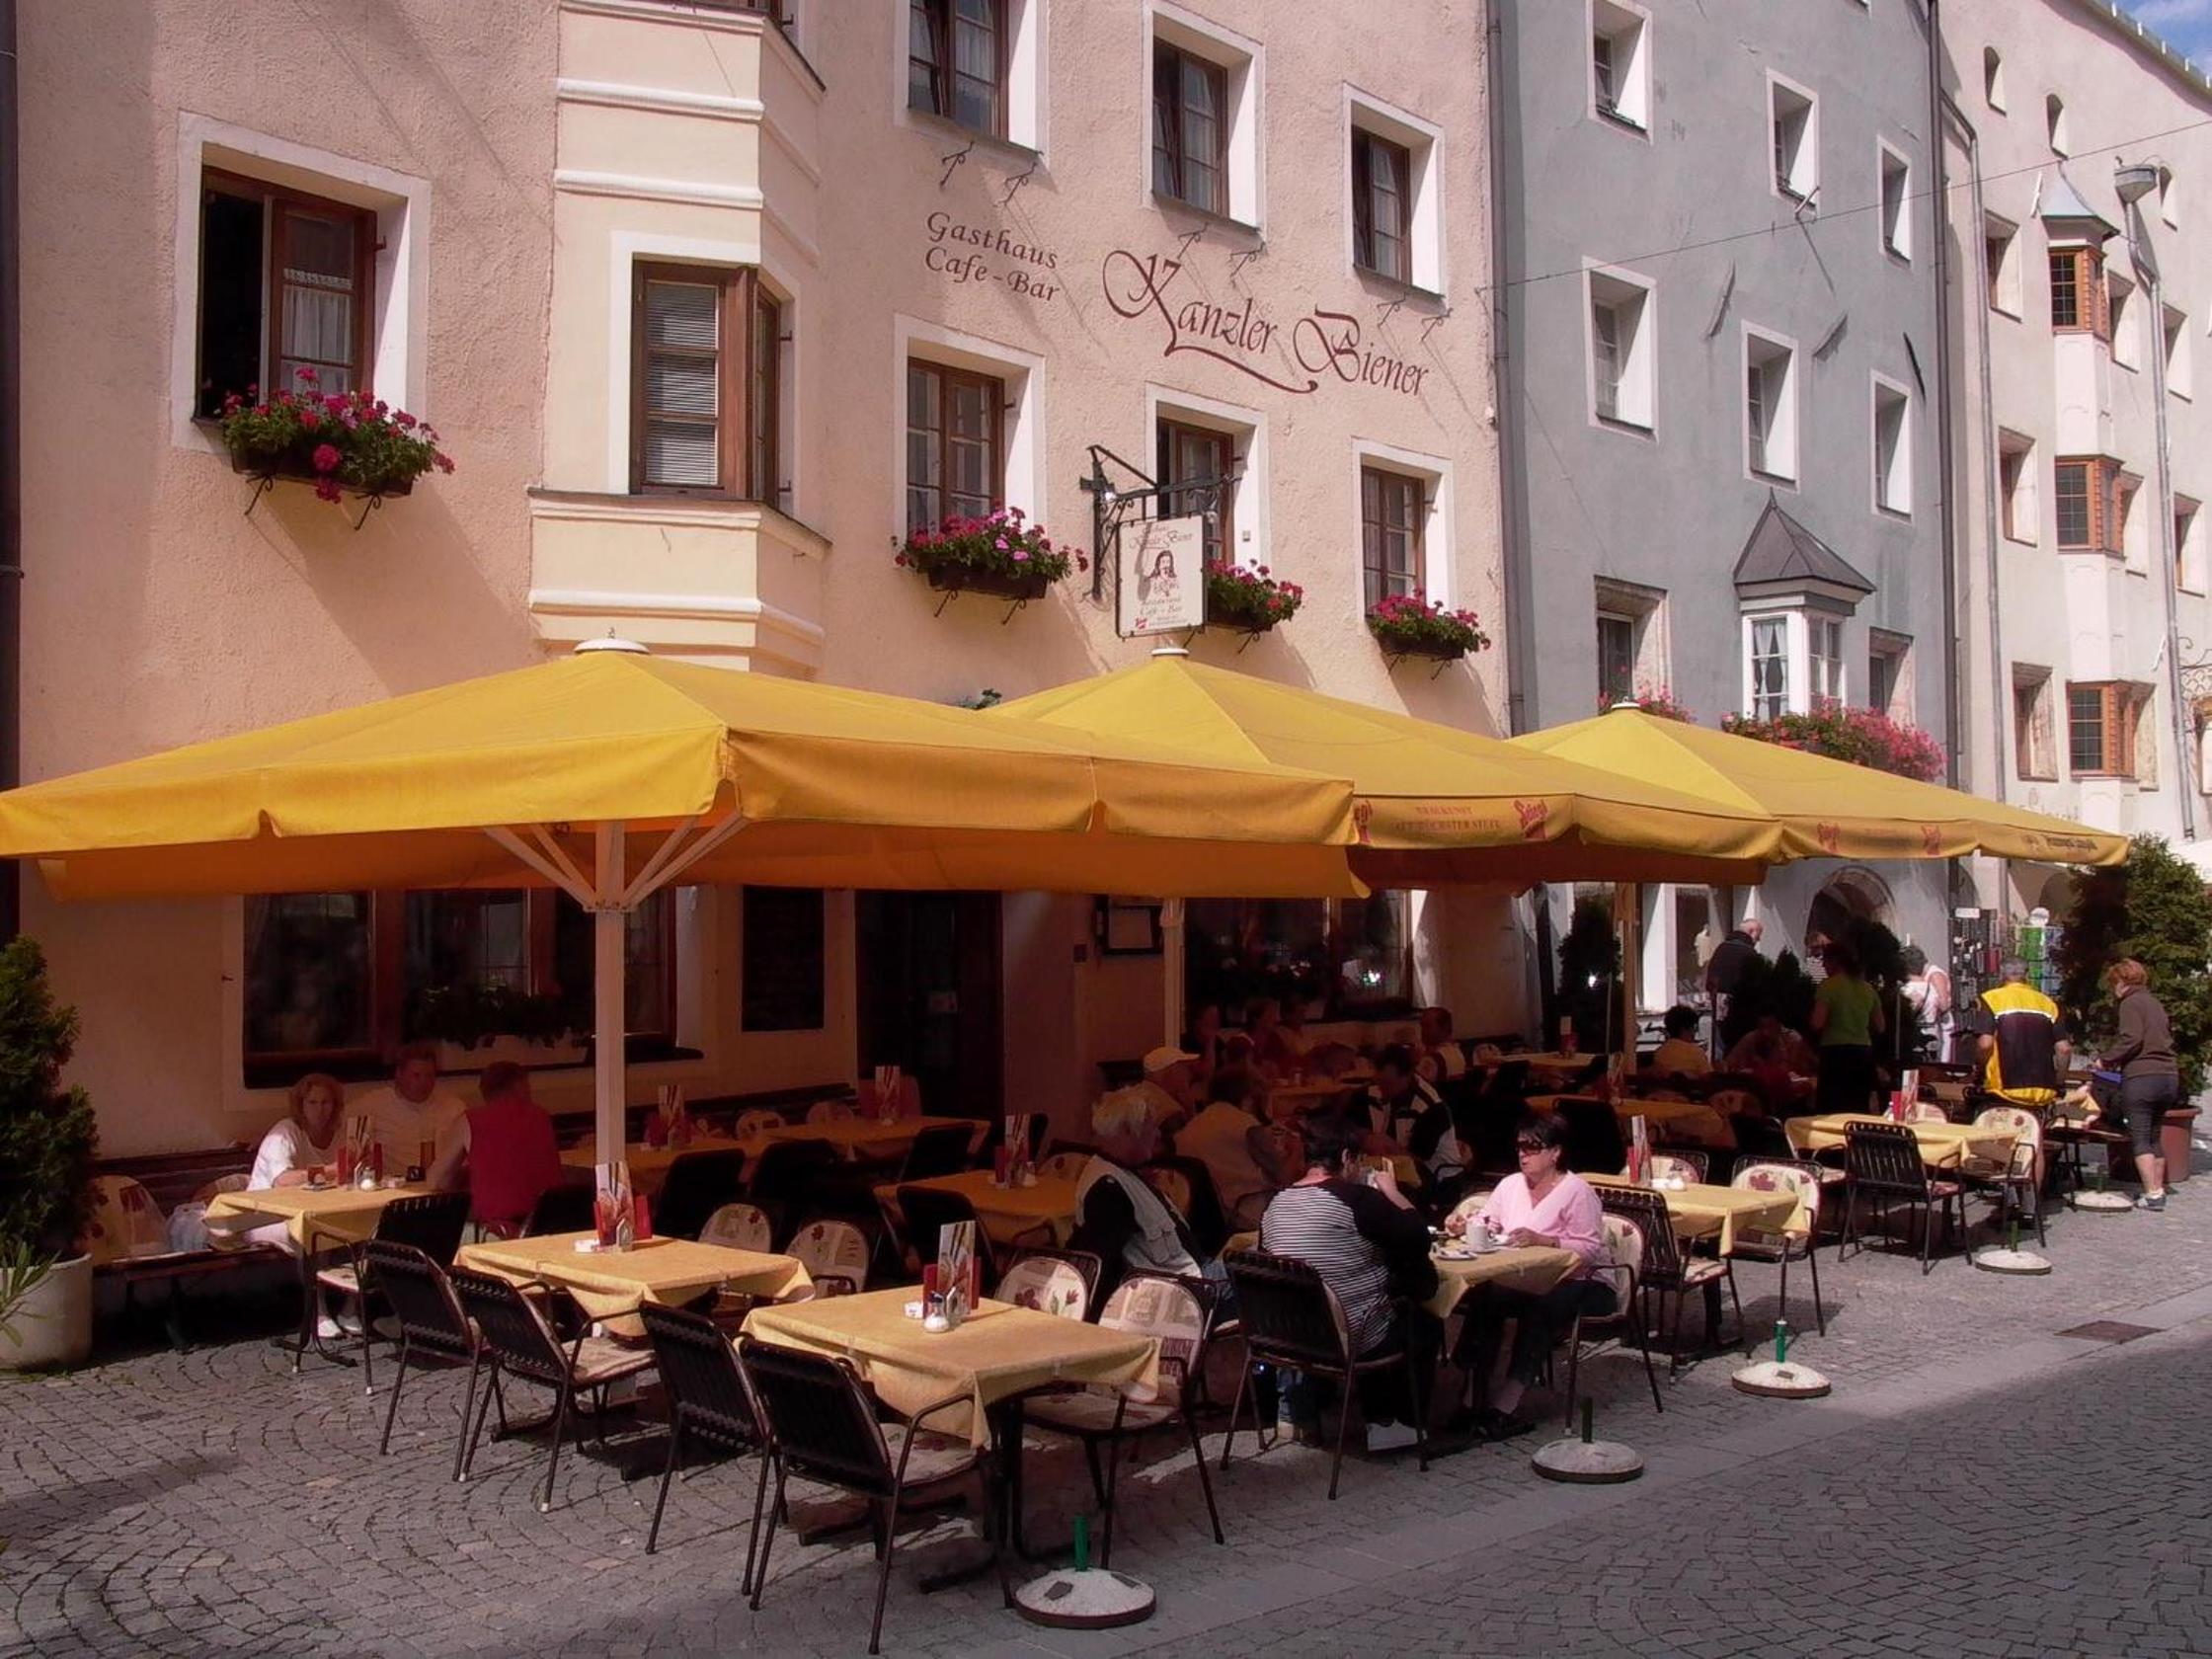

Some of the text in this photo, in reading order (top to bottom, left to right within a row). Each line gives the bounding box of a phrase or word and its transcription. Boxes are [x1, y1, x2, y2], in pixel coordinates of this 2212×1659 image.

[926, 210, 1059, 270] Gasthaus
[1102, 249, 1428, 396] Kanzler Biener
